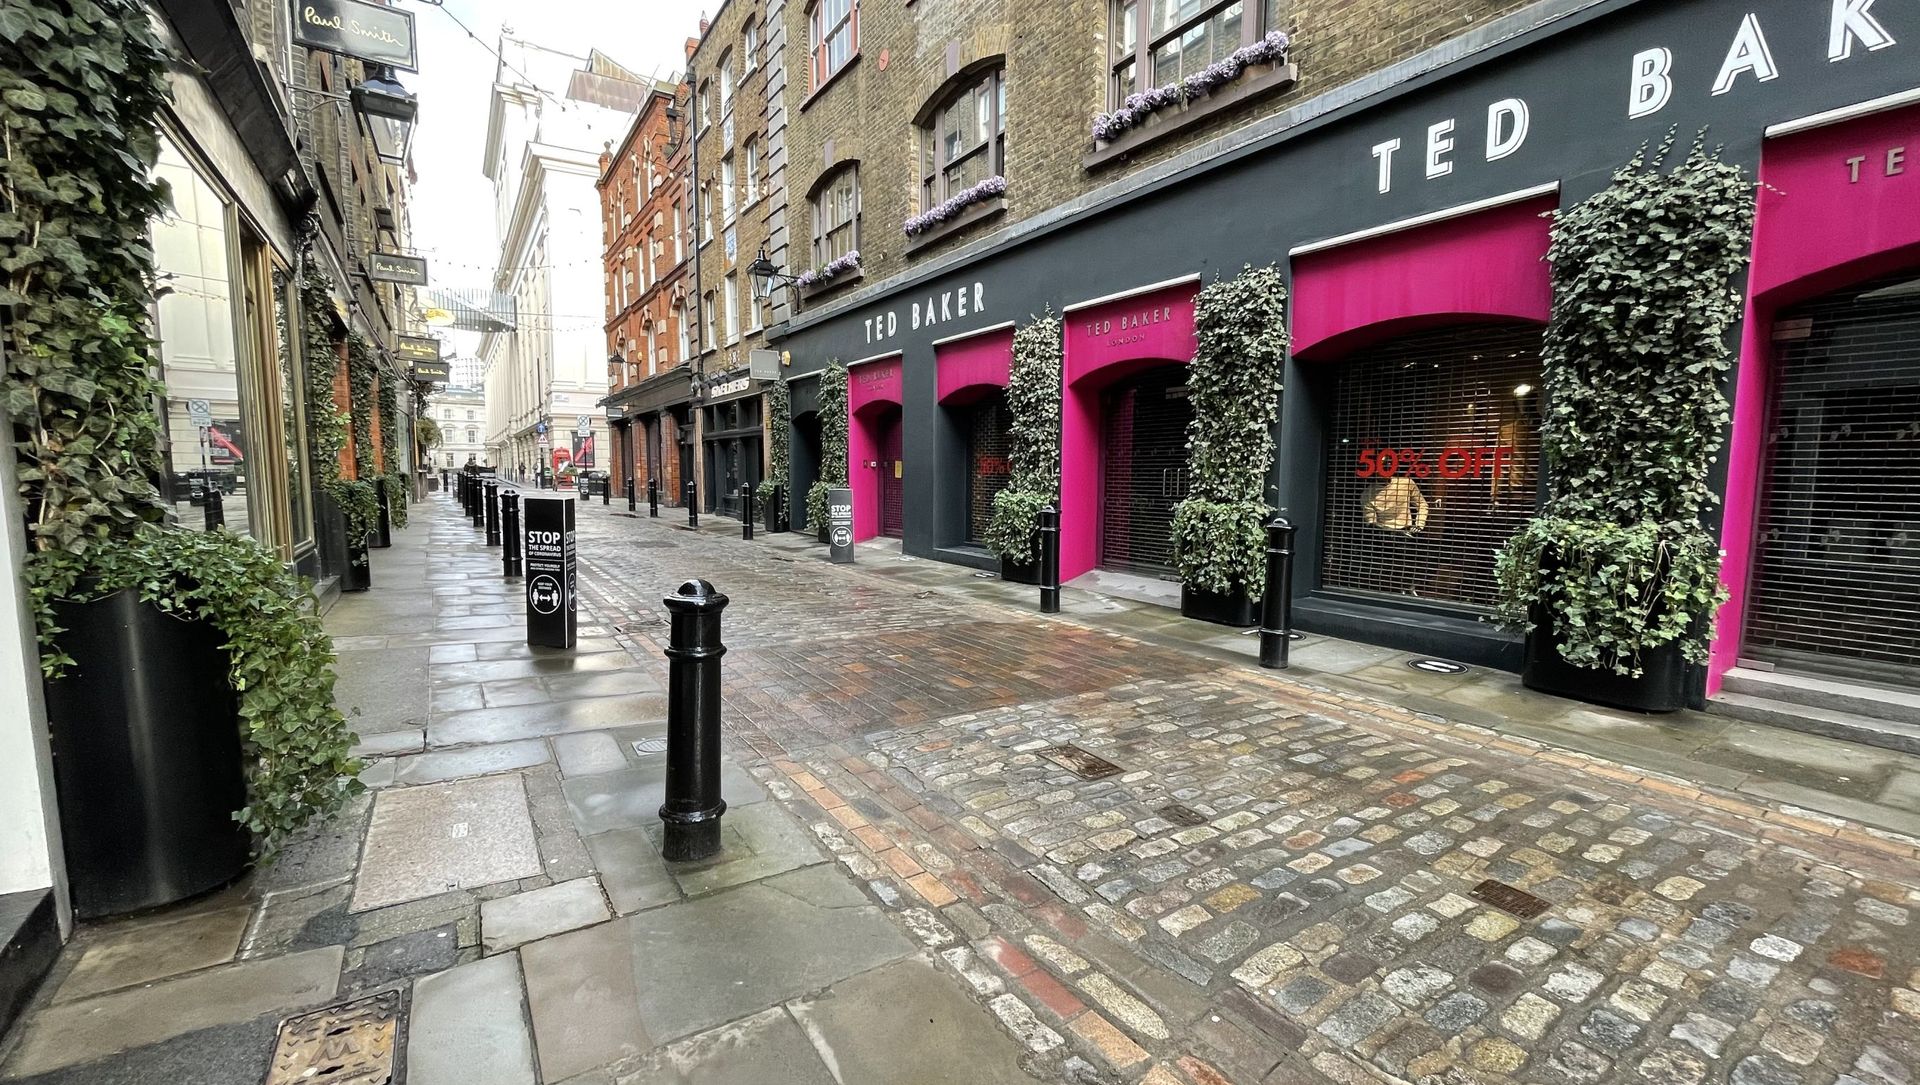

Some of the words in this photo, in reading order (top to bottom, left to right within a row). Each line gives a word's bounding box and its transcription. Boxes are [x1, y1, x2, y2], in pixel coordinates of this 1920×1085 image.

[304, 6, 345, 31] Paul
[351, 21, 404, 47] Smith
[1372, 98, 1529, 194] TED
[1628, 0, 1896, 120] BAK
[1846, 147, 1905, 183] TE
[864, 311, 897, 344] TED
[911, 282, 985, 330] BAKER
[1086, 320, 1111, 337] TED
[1121, 307, 1171, 330] BAKER
[1106, 332, 1145, 347] LONDON
[1356, 448, 1431, 478] 50%
[1438, 447, 1513, 478] OFF
[831, 504, 851, 512] STOP
[528, 530, 561, 544] STOP
